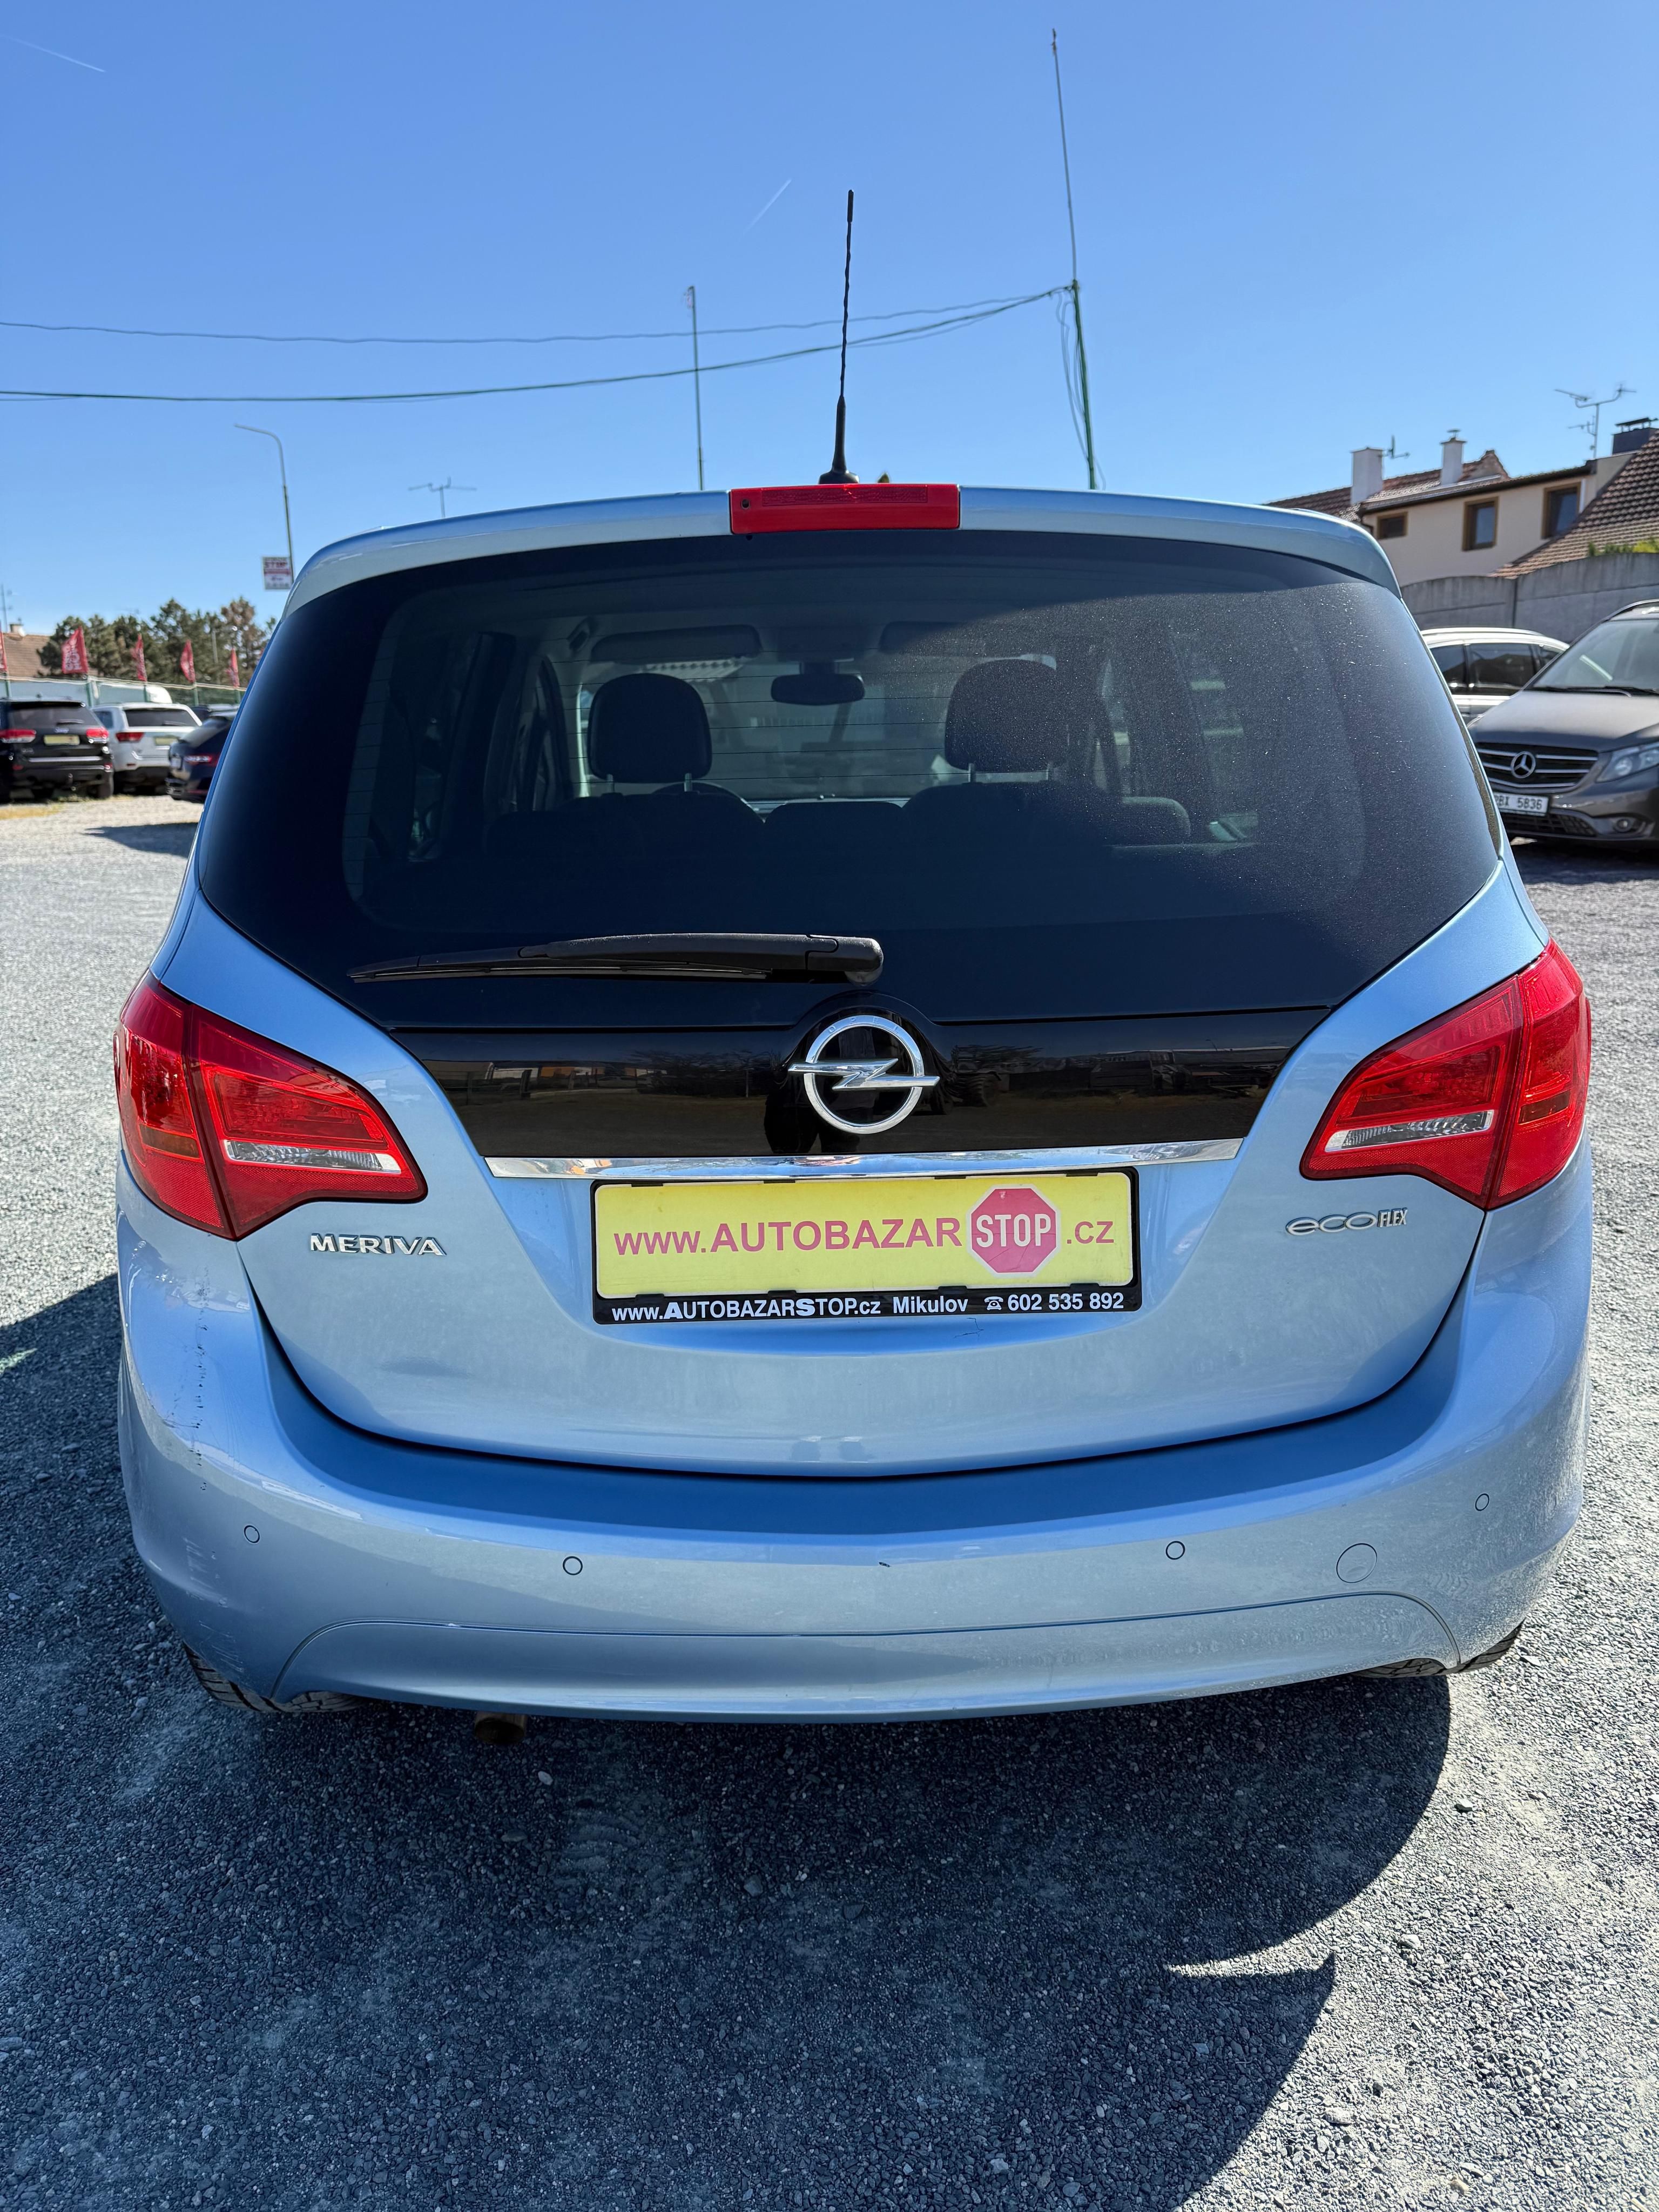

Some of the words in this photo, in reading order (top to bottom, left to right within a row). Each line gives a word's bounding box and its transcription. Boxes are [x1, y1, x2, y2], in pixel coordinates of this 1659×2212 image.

[1516, 797, 1543, 810] 5836
[828, 1016, 900, 1035] OPEL
[976, 1213, 1051, 1247] STOP
[310, 1232, 447, 1256] MERIVA
[611, 1298, 881, 1321] www.AUTOBAZARSTOP.cz
[893, 1296, 968, 1314] Mikulov
[1007, 1293, 1042, 1311] 602
[1048, 1293, 1083, 1311] 535
[1089, 1292, 1124, 1310] 892
